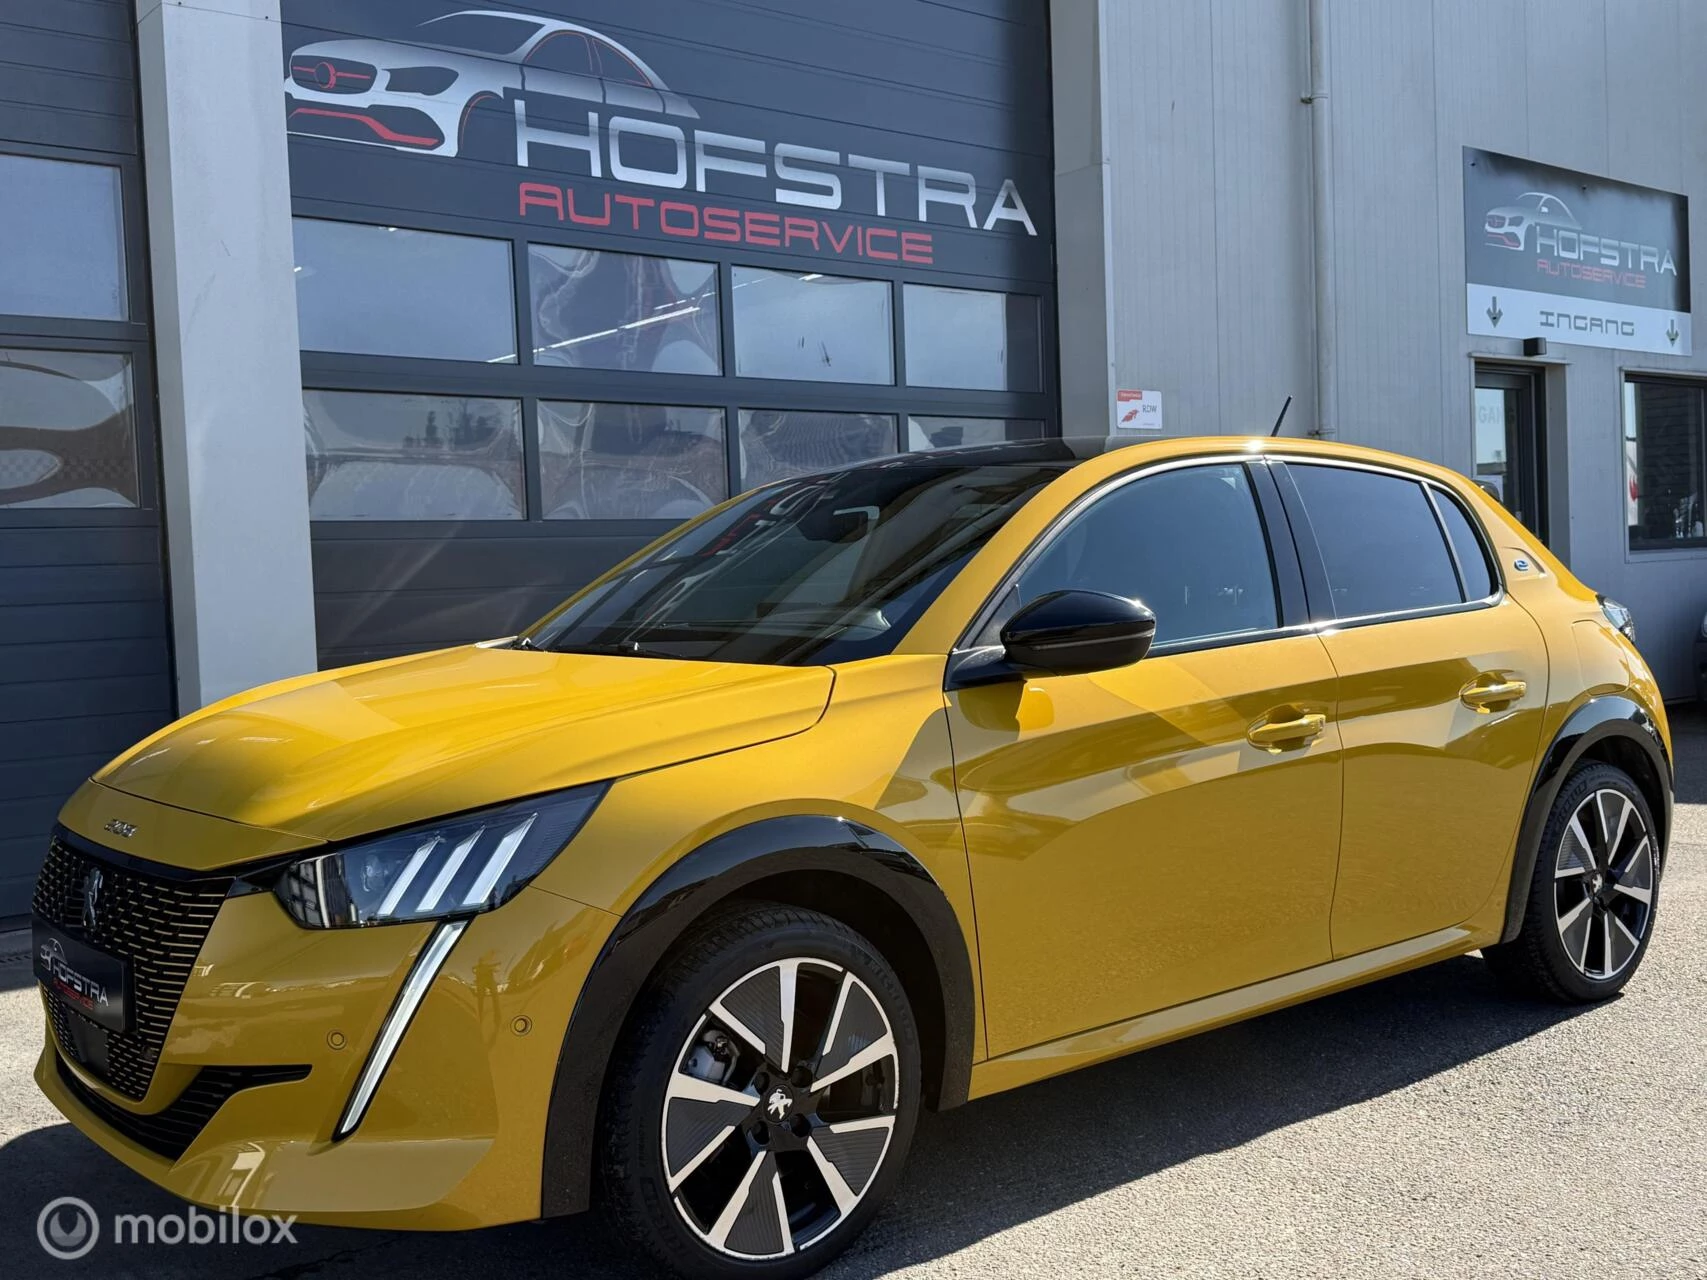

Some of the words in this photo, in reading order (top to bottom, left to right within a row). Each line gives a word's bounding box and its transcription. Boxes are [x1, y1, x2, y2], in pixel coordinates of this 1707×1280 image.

[513, 98, 1037, 237] HOFSTRA
[518, 181, 934, 265] AUTOSERVICE
[1536, 225, 1677, 277] HOFSTRA
[1536, 259, 1647, 289] AUTOSERVICE
[1539, 310, 1635, 336] INGANG
[52, 959, 109, 1007] HOFSTRA
